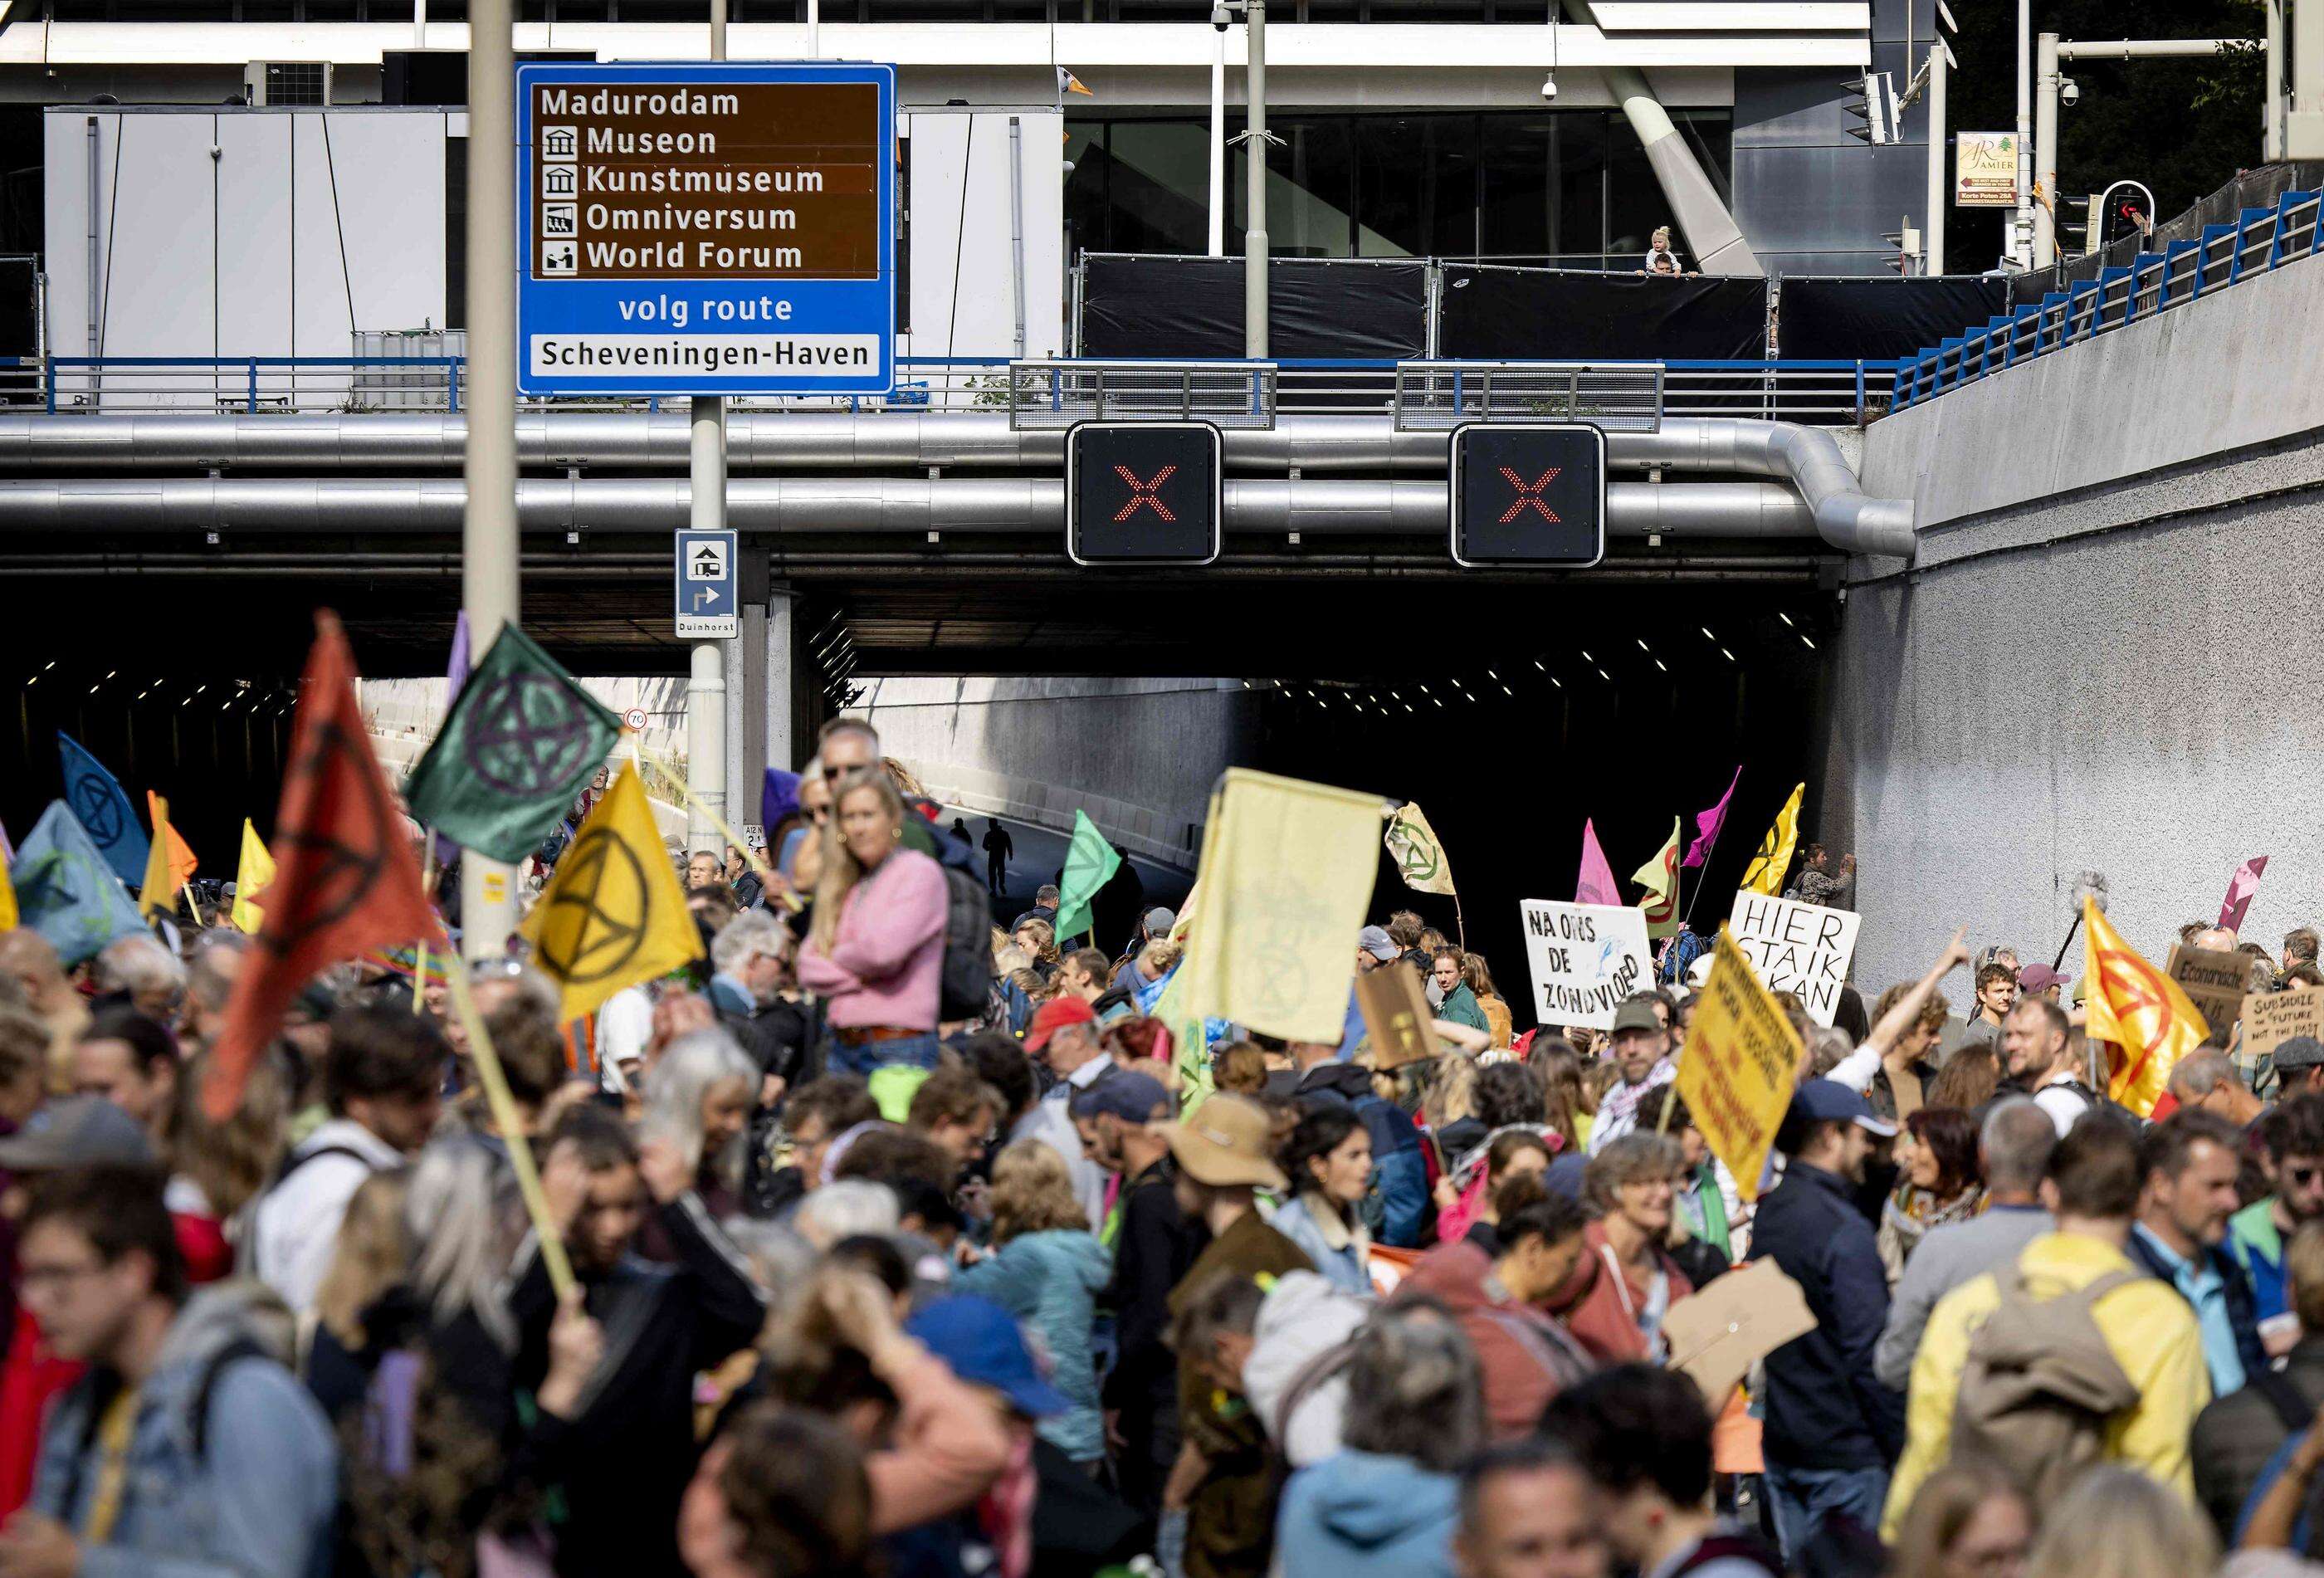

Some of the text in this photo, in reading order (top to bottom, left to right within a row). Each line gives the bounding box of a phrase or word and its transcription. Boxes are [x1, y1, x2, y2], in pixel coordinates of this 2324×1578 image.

[541, 89, 740, 115] Madurodam
[586, 126, 716, 154] Museon
[1980, 161, 2014, 169] AMIER
[586, 166, 823, 193] Kunstmuseum
[586, 203, 797, 231] Omniversum
[586, 242, 803, 269] World Forum
[618, 294, 793, 328] volg route
[542, 340, 869, 372] Scheveningen-Haven
[679, 623, 734, 631] Duinhorst
[630, 715, 644, 723] 70
[1528, 910, 1557, 937] NA
[1744, 900, 1843, 951] HIER
[1548, 947, 1572, 974] DE
[2253, 993, 2315, 1014] SUBSIDIZE
[2252, 1028, 2269, 1041] NOT
